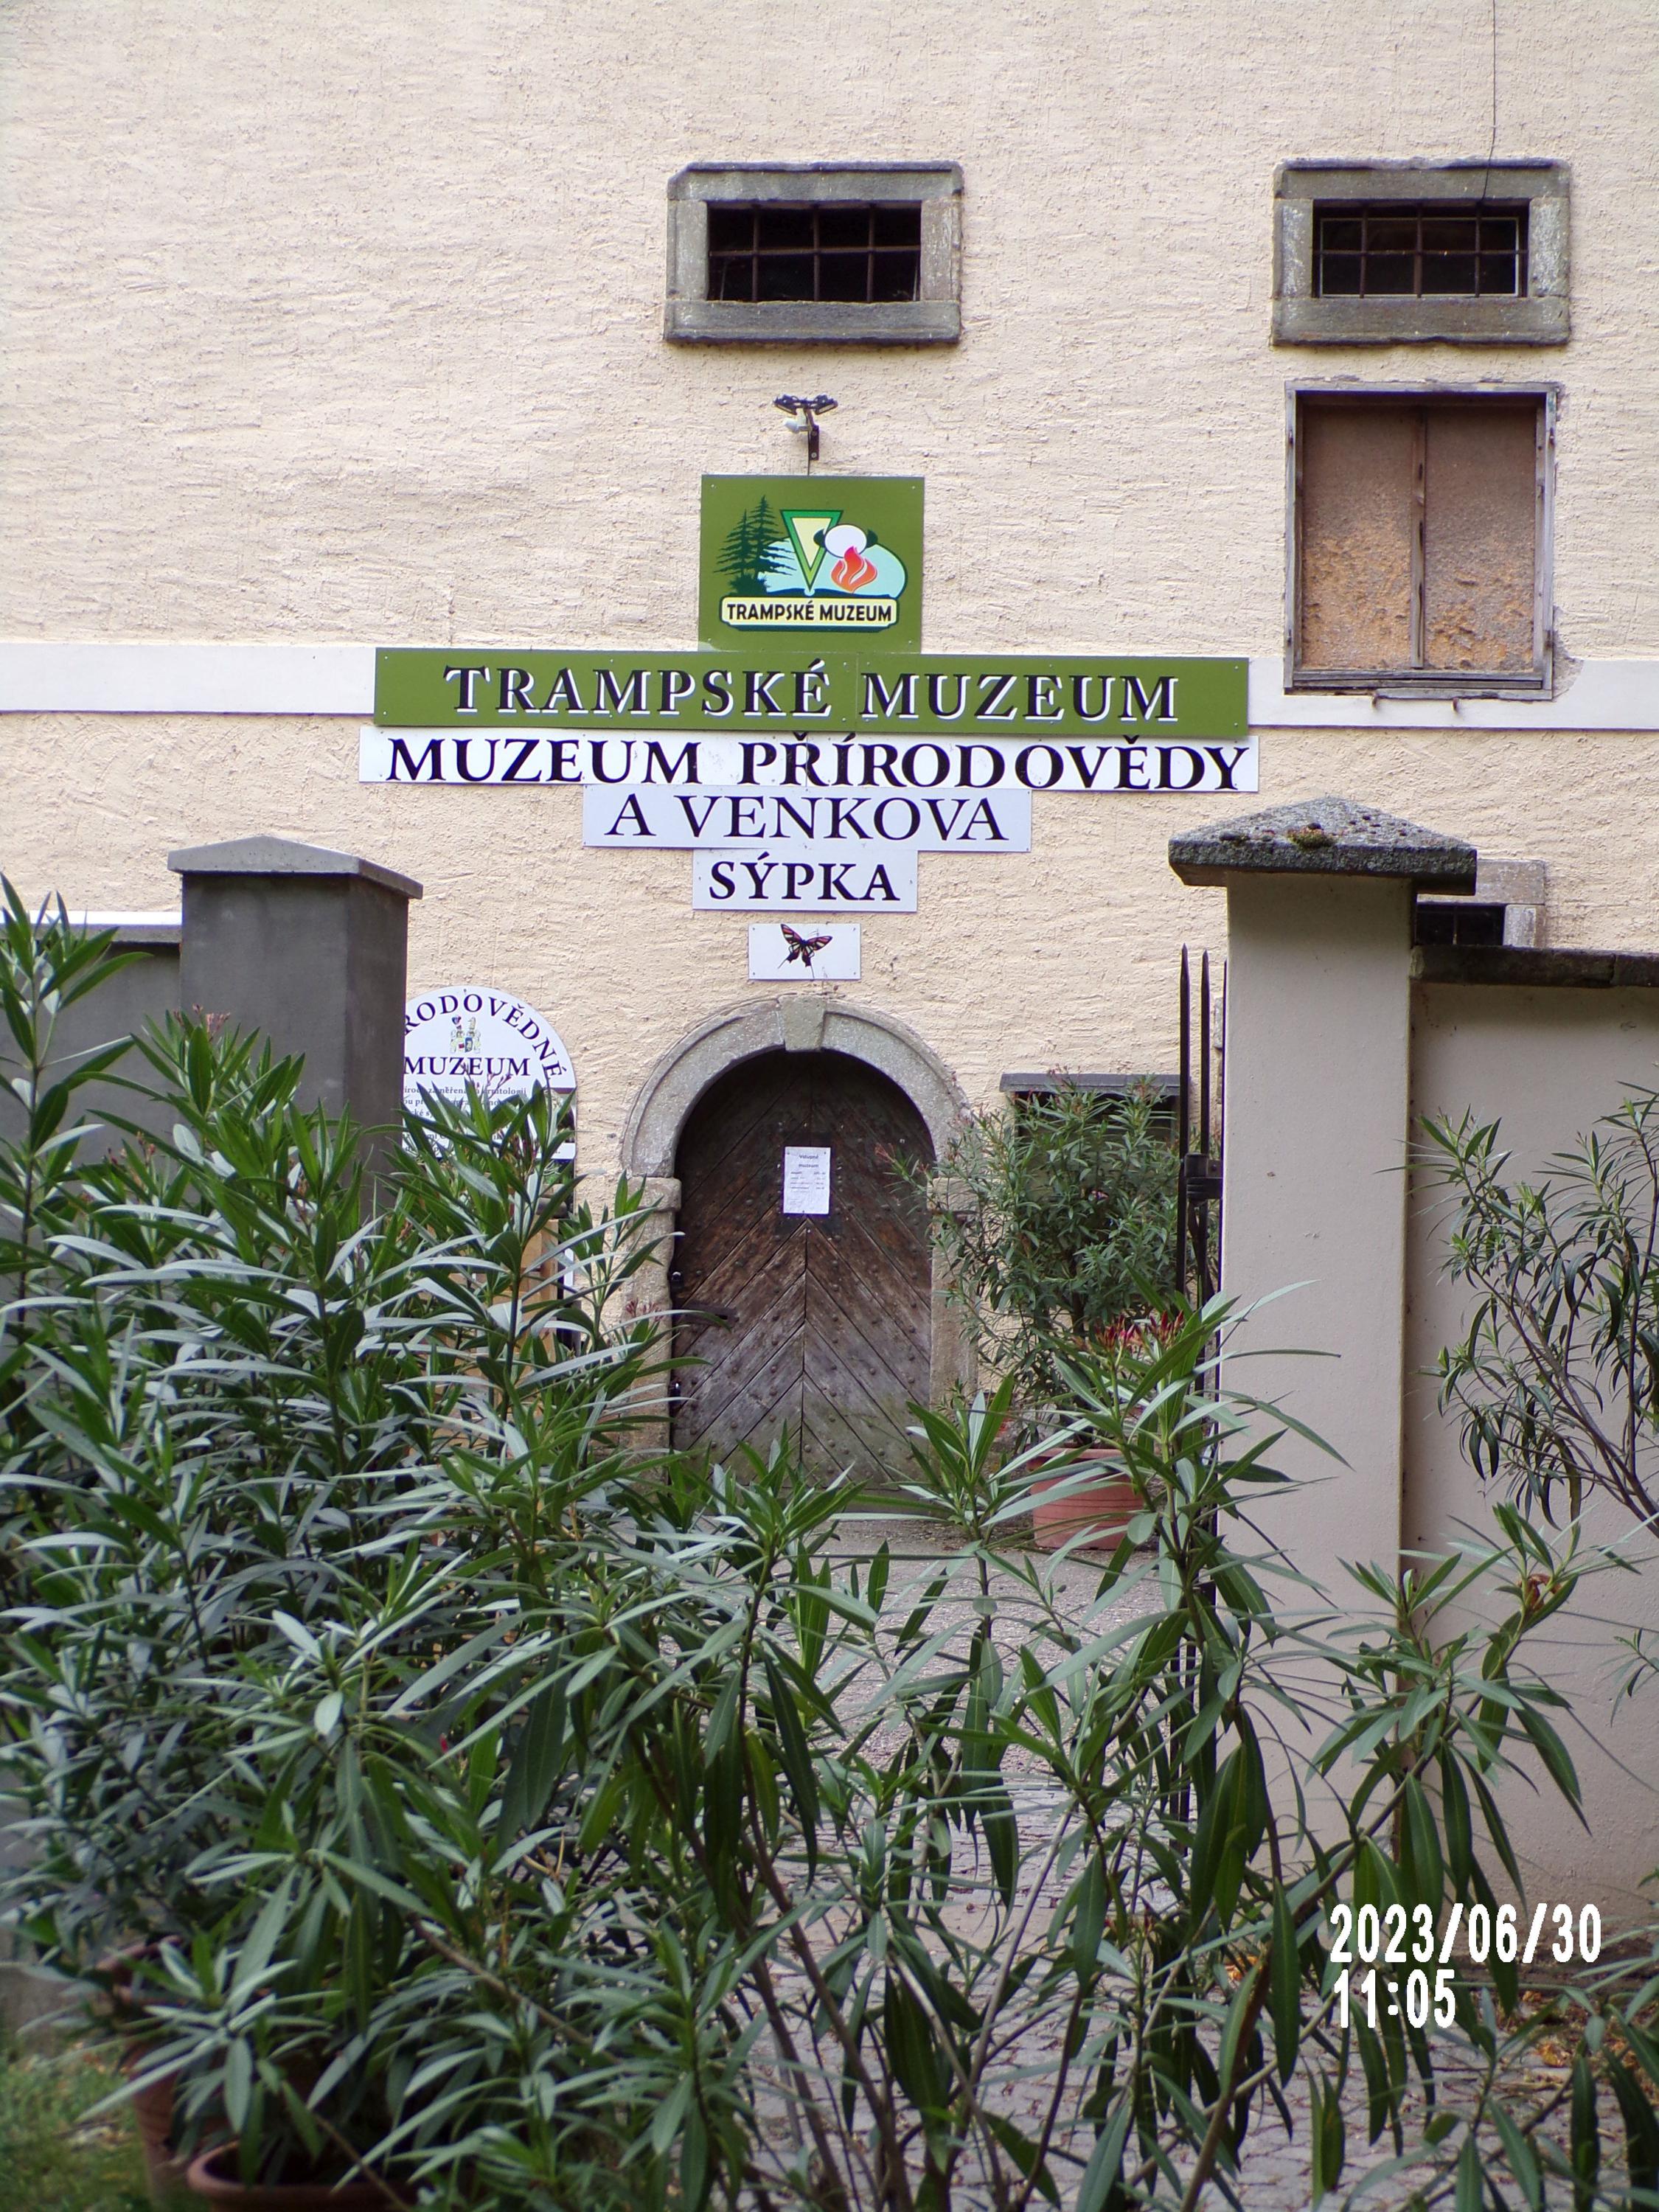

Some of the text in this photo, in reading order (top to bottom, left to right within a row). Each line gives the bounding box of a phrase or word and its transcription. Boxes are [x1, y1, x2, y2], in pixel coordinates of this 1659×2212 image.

[726, 600, 892, 622] TRAMPSKÉ MUZEUM
[442, 658, 1179, 723] TRAMPSKÉ MUZEUM
[385, 737, 702, 785] MUZEUM
[605, 793, 1009, 842] A VENKOVA
[708, 851, 901, 901] SÝPKA
[405, 994, 567, 1080] RODOVĚDNÉ
[404, 1057, 531, 1077] MUZEUM
